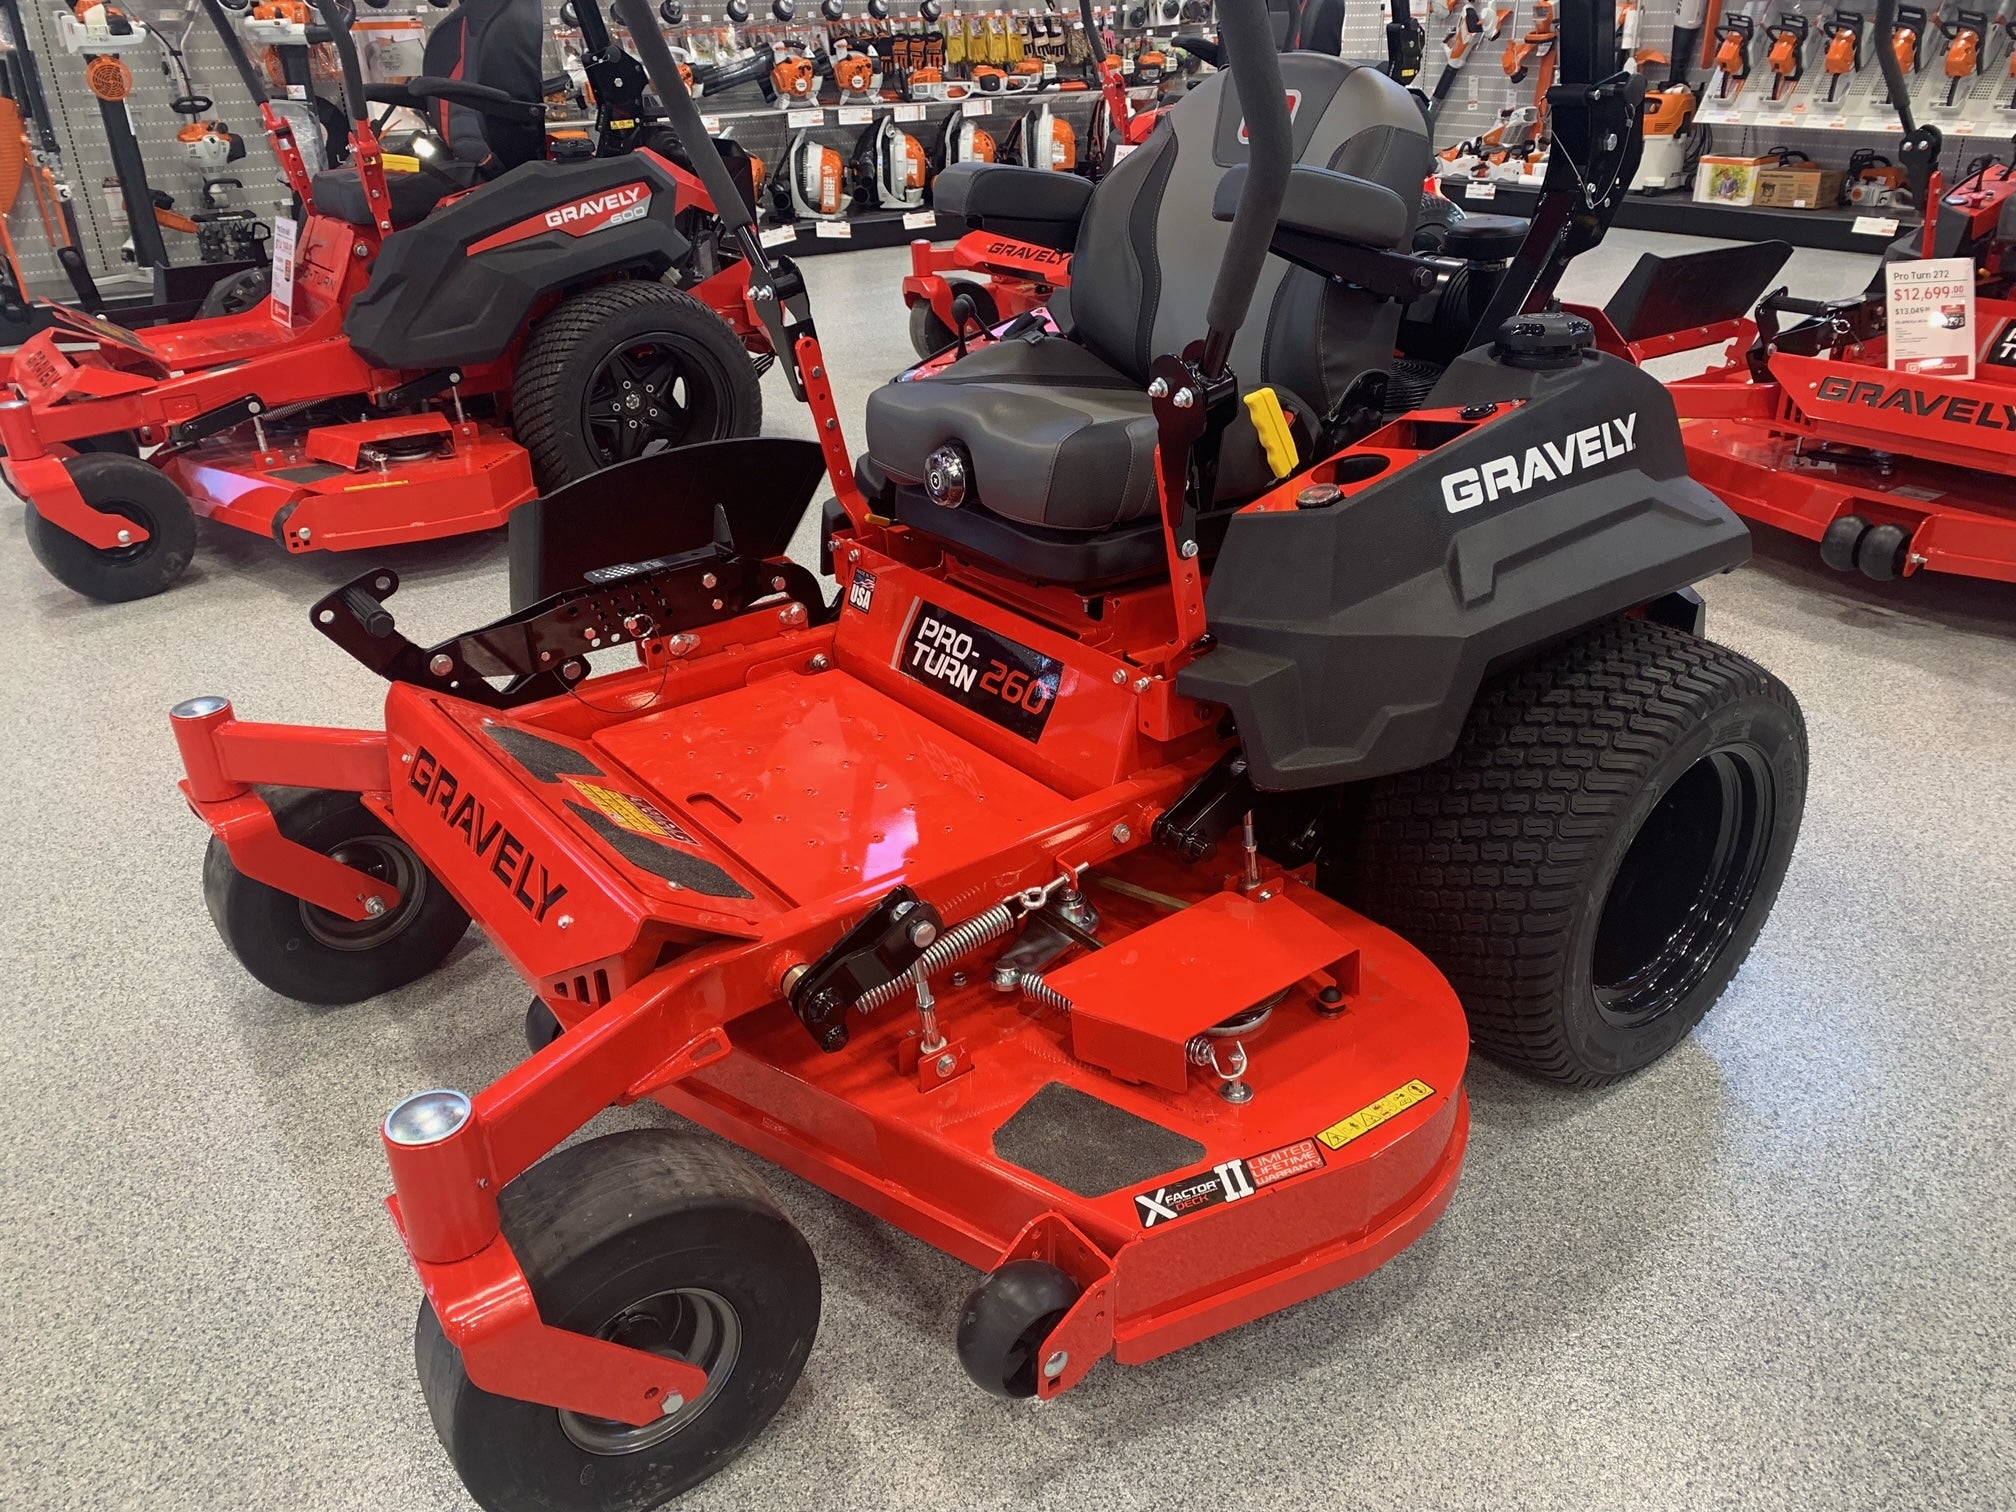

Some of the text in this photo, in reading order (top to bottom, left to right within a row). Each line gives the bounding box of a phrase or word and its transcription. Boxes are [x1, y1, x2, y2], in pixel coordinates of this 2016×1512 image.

[545, 187, 640, 228] GRAVELY
[610, 206, 646, 224] 600
[988, 242, 1072, 265] GRAVELY
[1893, 270, 1950, 281] Pro Turn 272
[1441, 412, 1637, 514] GRAVELY
[850, 583, 871, 610] USA
[917, 616, 980, 659] PRO-
[911, 640, 1047, 716] TURN 260
[408, 745, 569, 926] GRAVELY
[1248, 1141, 1313, 1170] LIMITED
[1252, 1151, 1316, 1177] LIFETIME
[1256, 1158, 1322, 1186] WARRANTY
[1135, 1188, 1178, 1228] X
[1215, 1158, 1255, 1203] II
[1176, 1194, 1209, 1212] DECK
